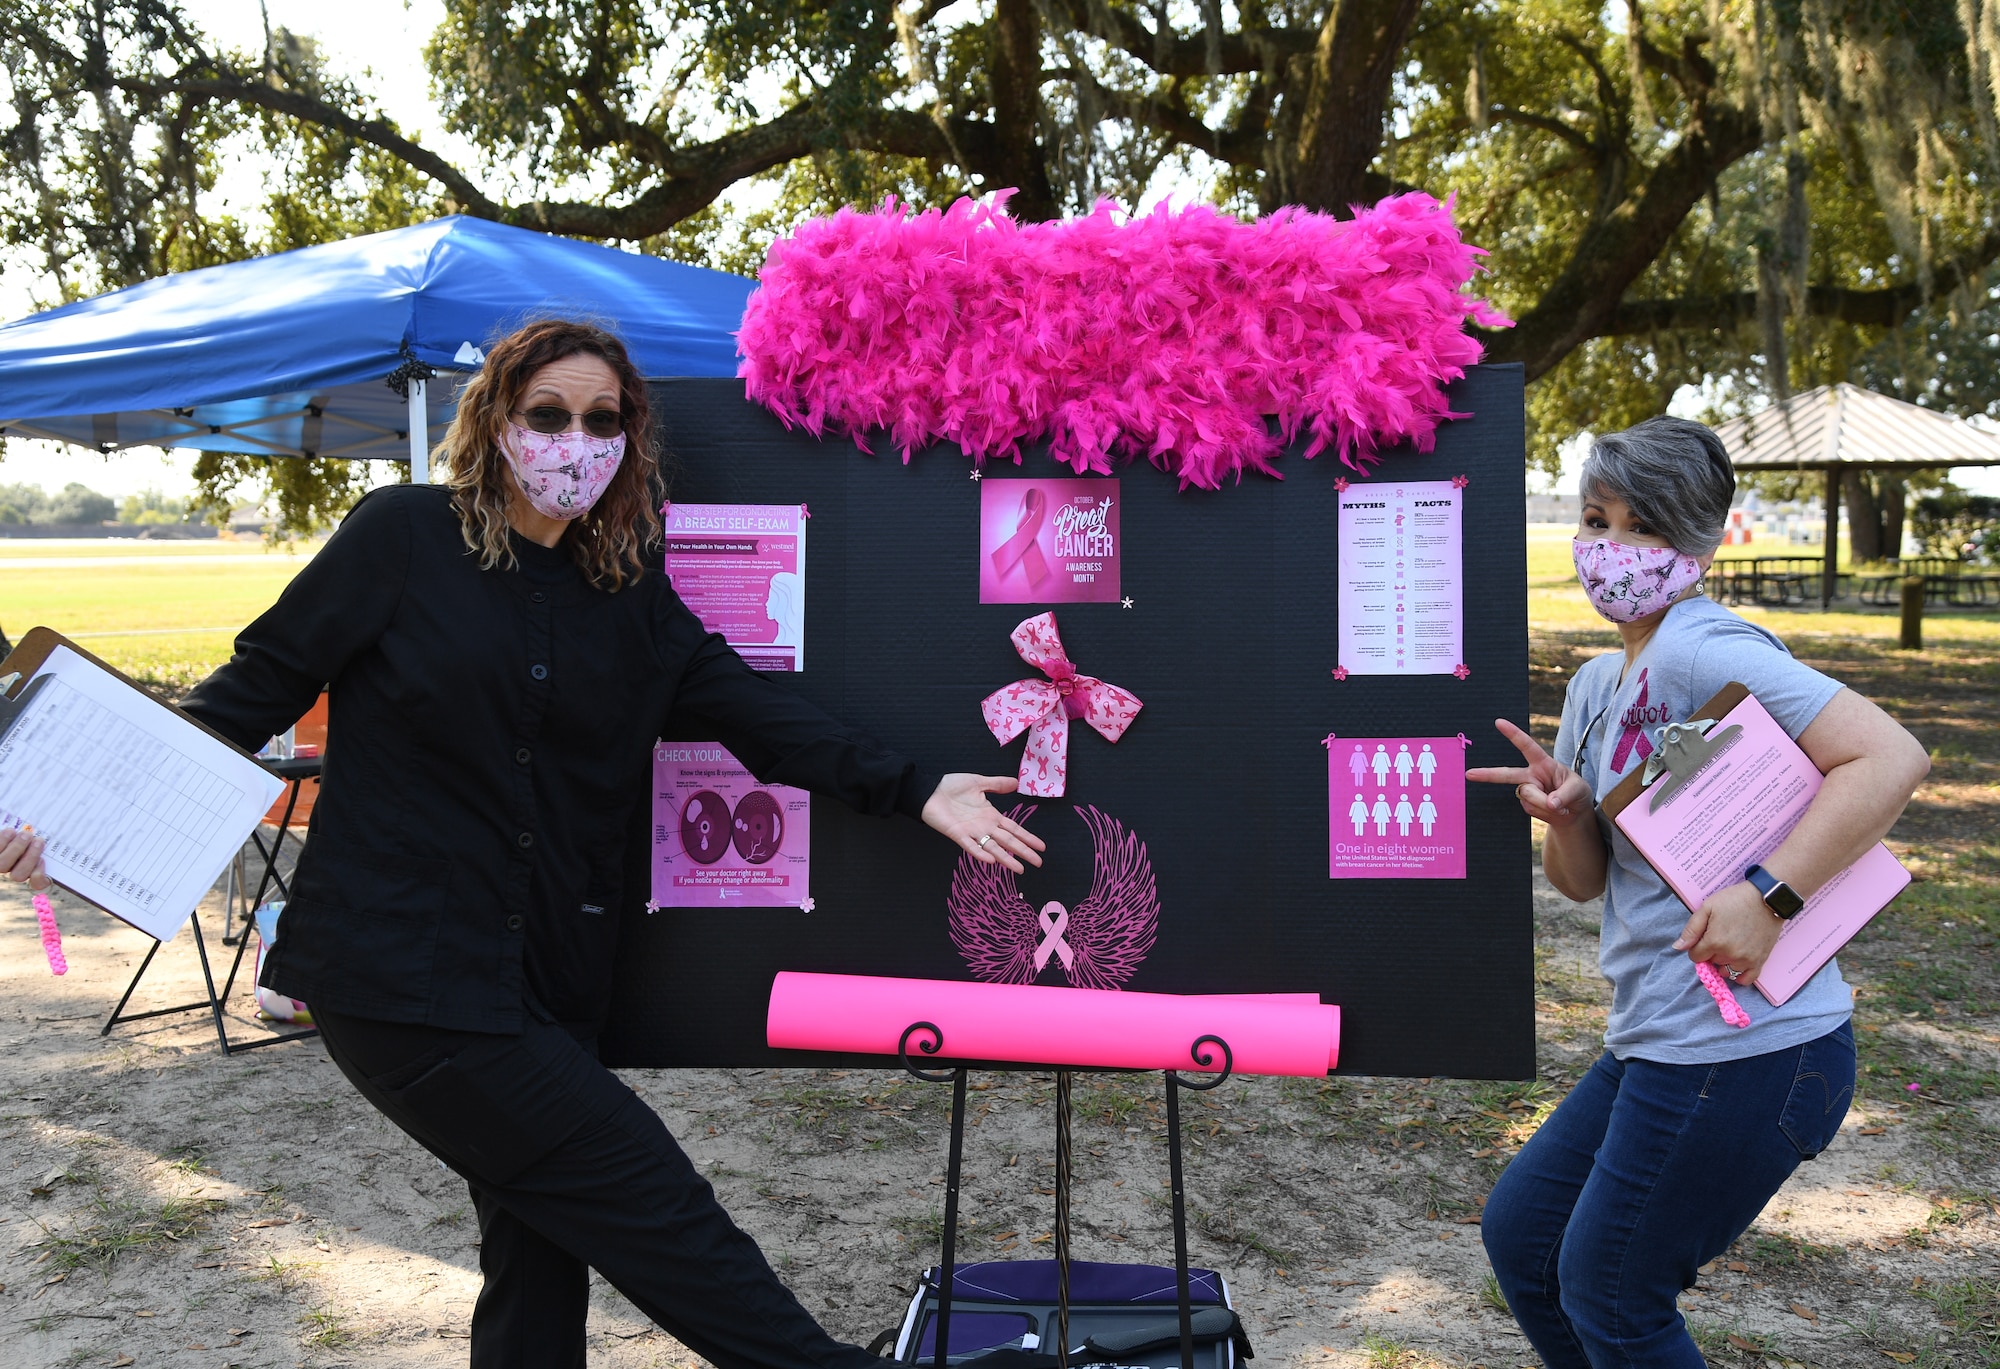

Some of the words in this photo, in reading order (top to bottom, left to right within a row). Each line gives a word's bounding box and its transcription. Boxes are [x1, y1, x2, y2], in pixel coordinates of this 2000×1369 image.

[1074, 496, 1094, 504] OCTOBER
[674, 507, 722, 516] STEP-BY-STEP
[724, 507, 738, 516] FOR
[740, 507, 790, 516] CONDUCTING
[1053, 496, 1114, 538] Breast
[674, 517, 682, 528] A
[685, 517, 726, 529] BREAST
[728, 518, 789, 530] SELF-EXAM
[1054, 534, 1114, 557] CANCER
[1066, 562, 1102, 572] AWARENESS
[1073, 574, 1094, 582] MONTH
[1618, 702, 1672, 726] vivor
[3, 727, 21, 749] OCTOBER
[19, 716, 30, 728] 2020
[657, 750, 692, 762] CHECK
[694, 750, 722, 762] YOUR
[722, 770, 746, 778] symptoms
[1336, 843, 1361, 854] One
[1364, 843, 1374, 854] in
[1377, 843, 1407, 856] eight
[1410, 844, 1454, 854] women
[738, 870, 751, 878] right
[684, 878, 694, 886] you
[713, 878, 722, 886] any
[724, 877, 743, 886] change
[751, 876, 784, 886] abnormality
